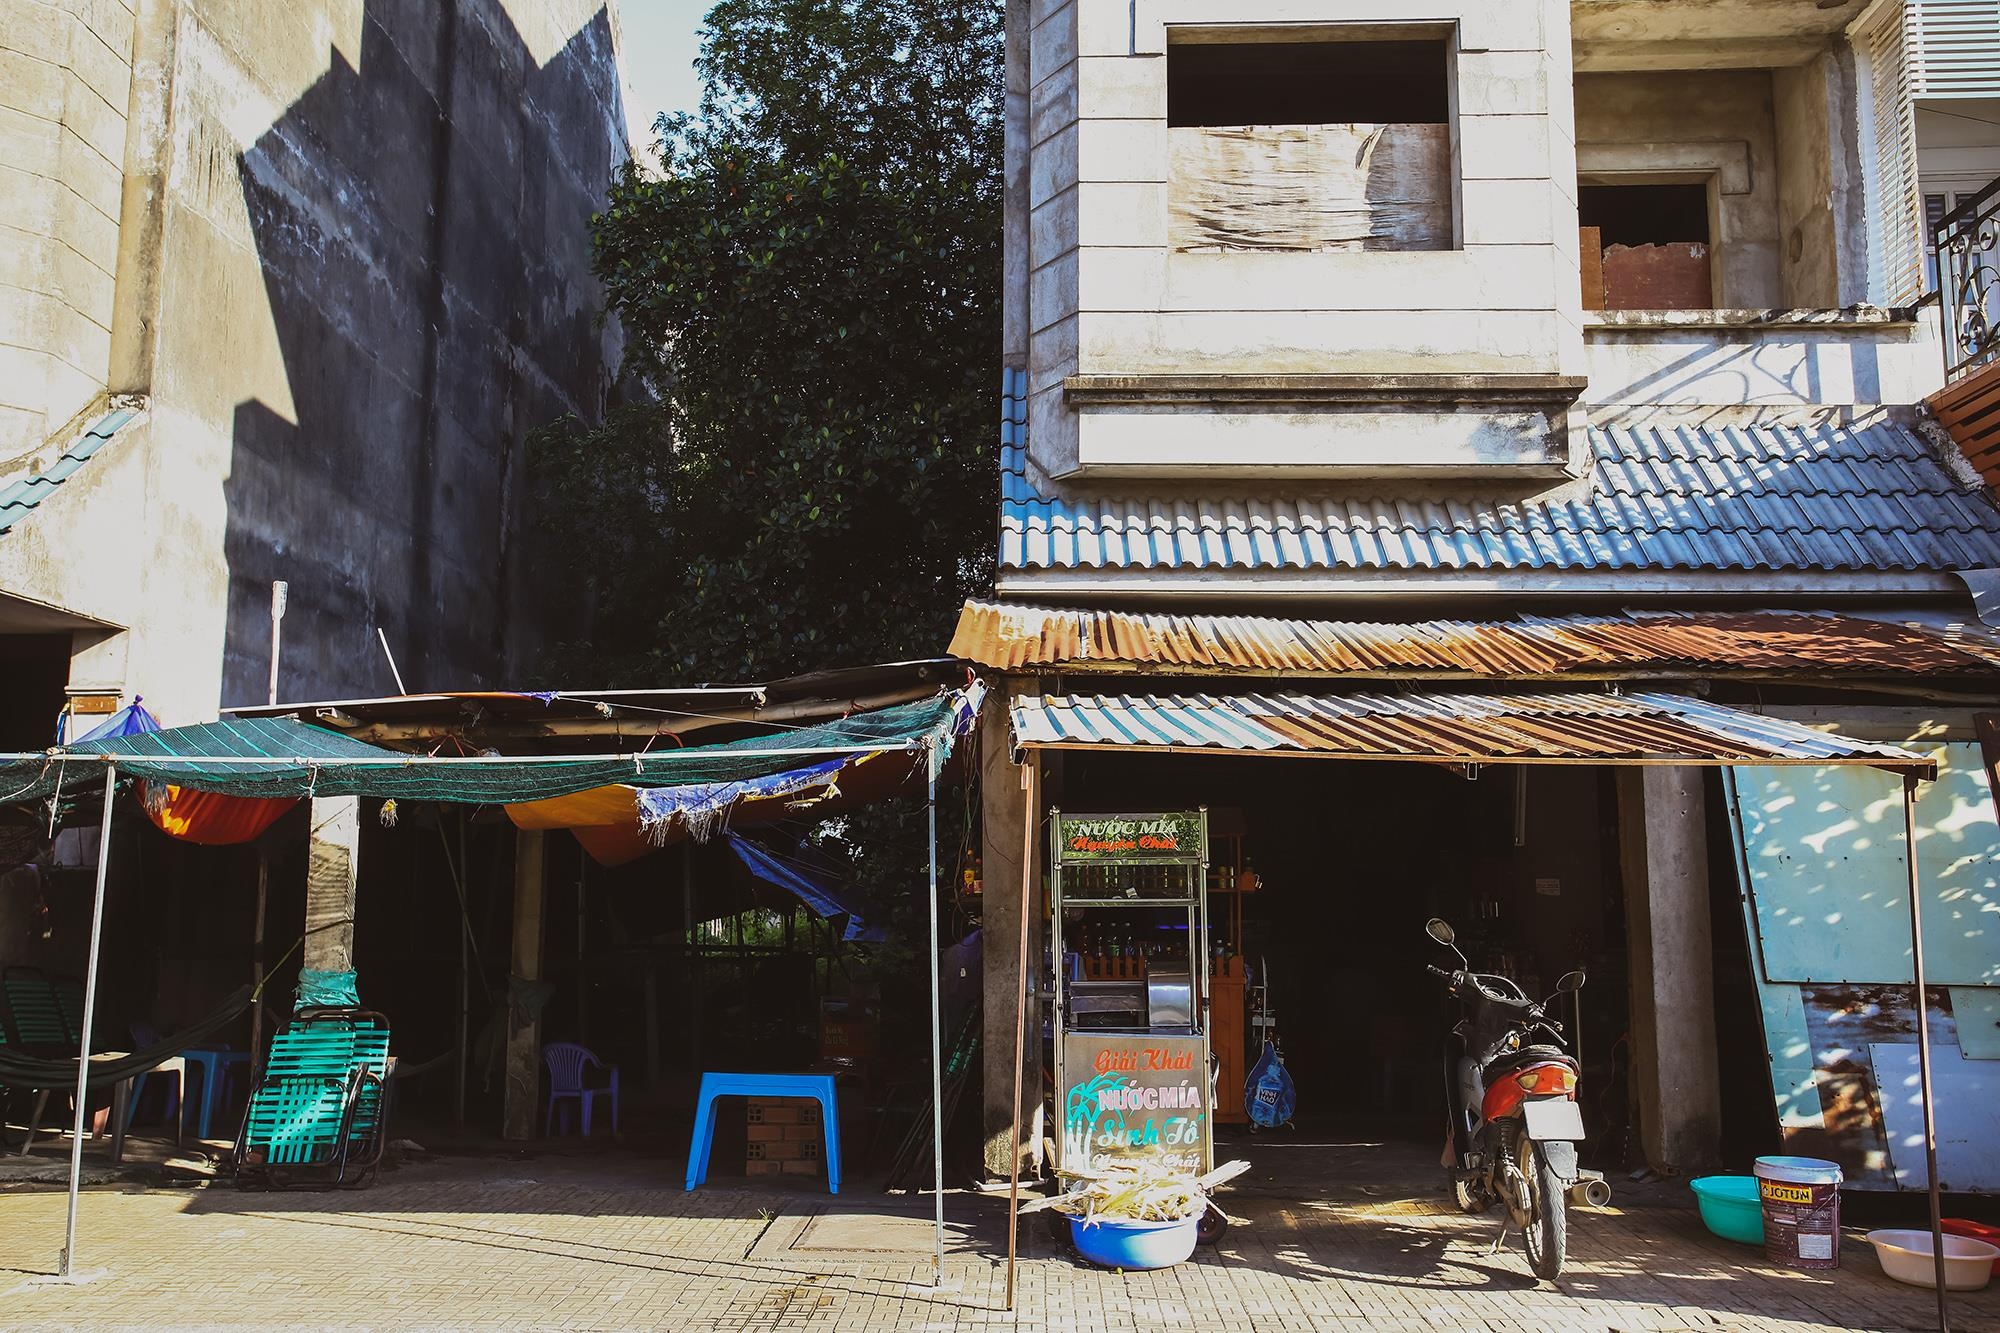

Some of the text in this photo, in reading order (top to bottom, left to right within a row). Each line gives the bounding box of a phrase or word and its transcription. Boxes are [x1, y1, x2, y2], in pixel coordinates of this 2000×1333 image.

[1094, 1049, 1138, 1076] Giải
[1097, 1119, 1160, 1147] Sinh
[1770, 1186, 1809, 1200] JOTUN
